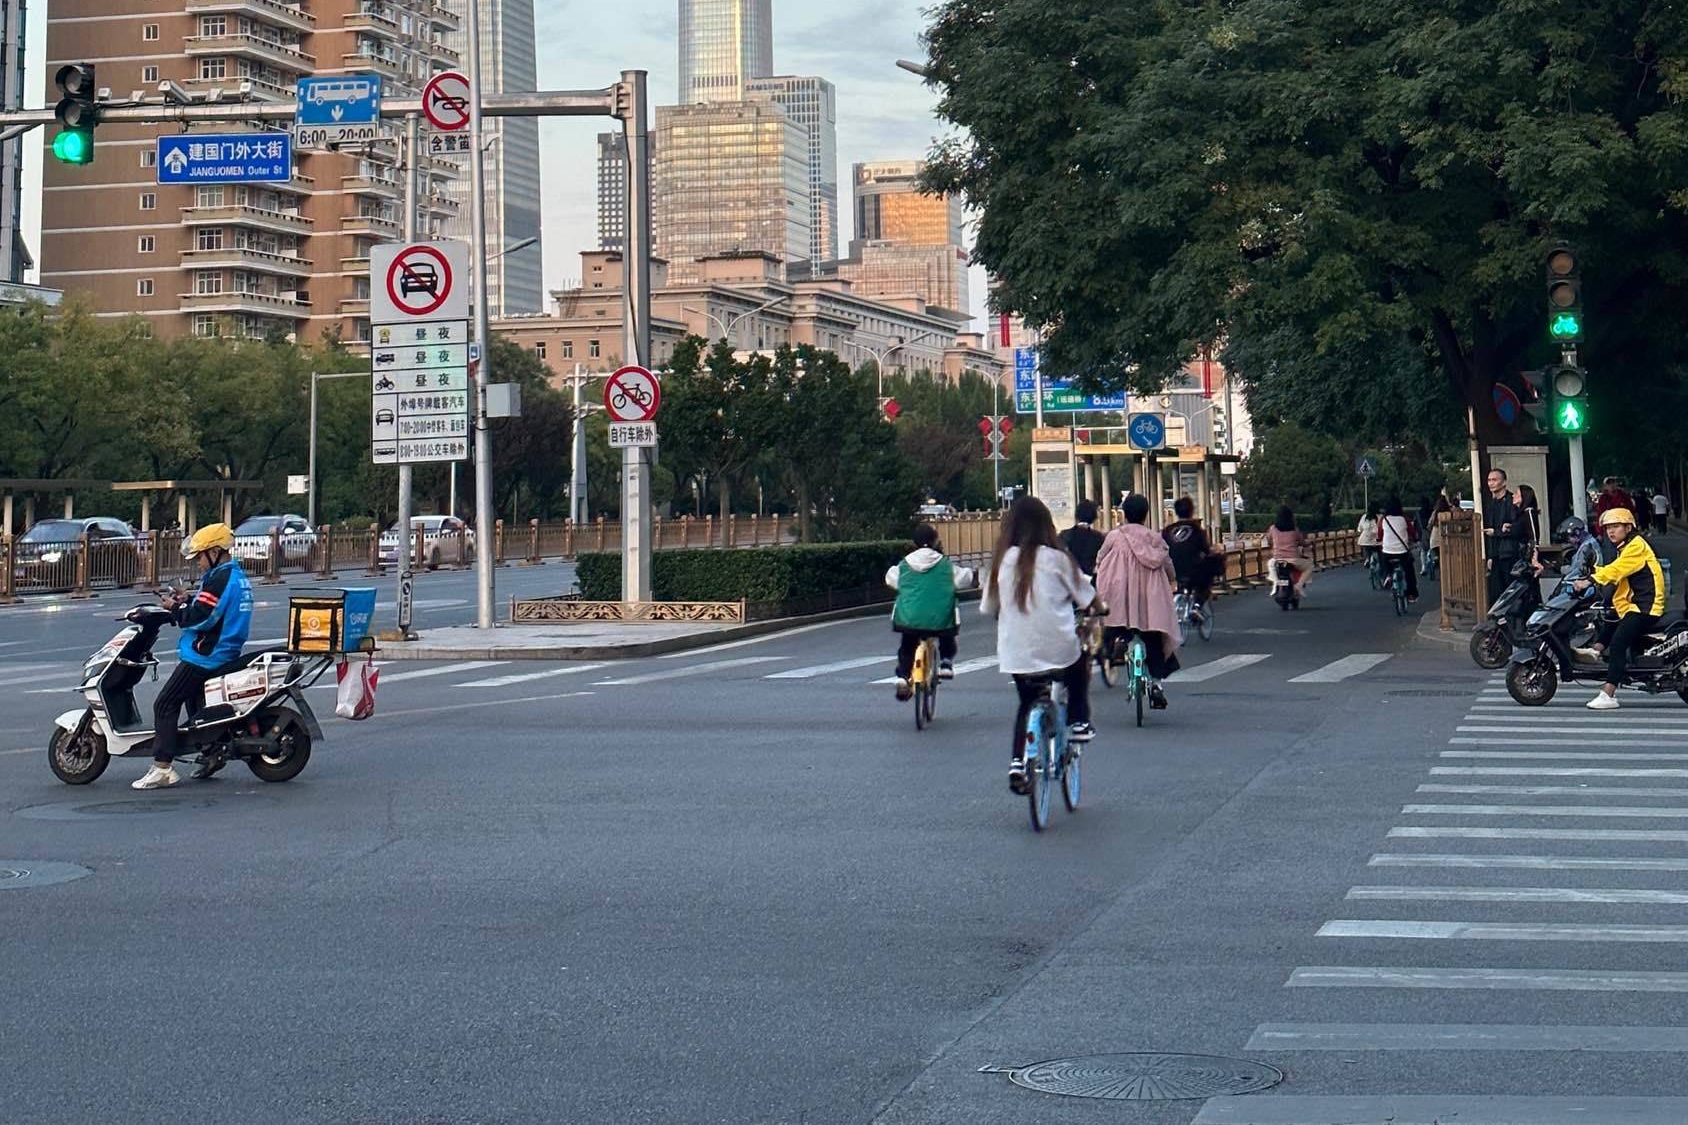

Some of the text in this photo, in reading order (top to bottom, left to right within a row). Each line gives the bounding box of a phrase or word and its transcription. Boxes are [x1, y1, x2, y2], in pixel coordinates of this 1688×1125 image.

[188, 140, 283, 161] 建国门外大街
[189, 165, 283, 177] JIANGUOMEN Outer St
[611, 425, 654, 443] 自行车除外
